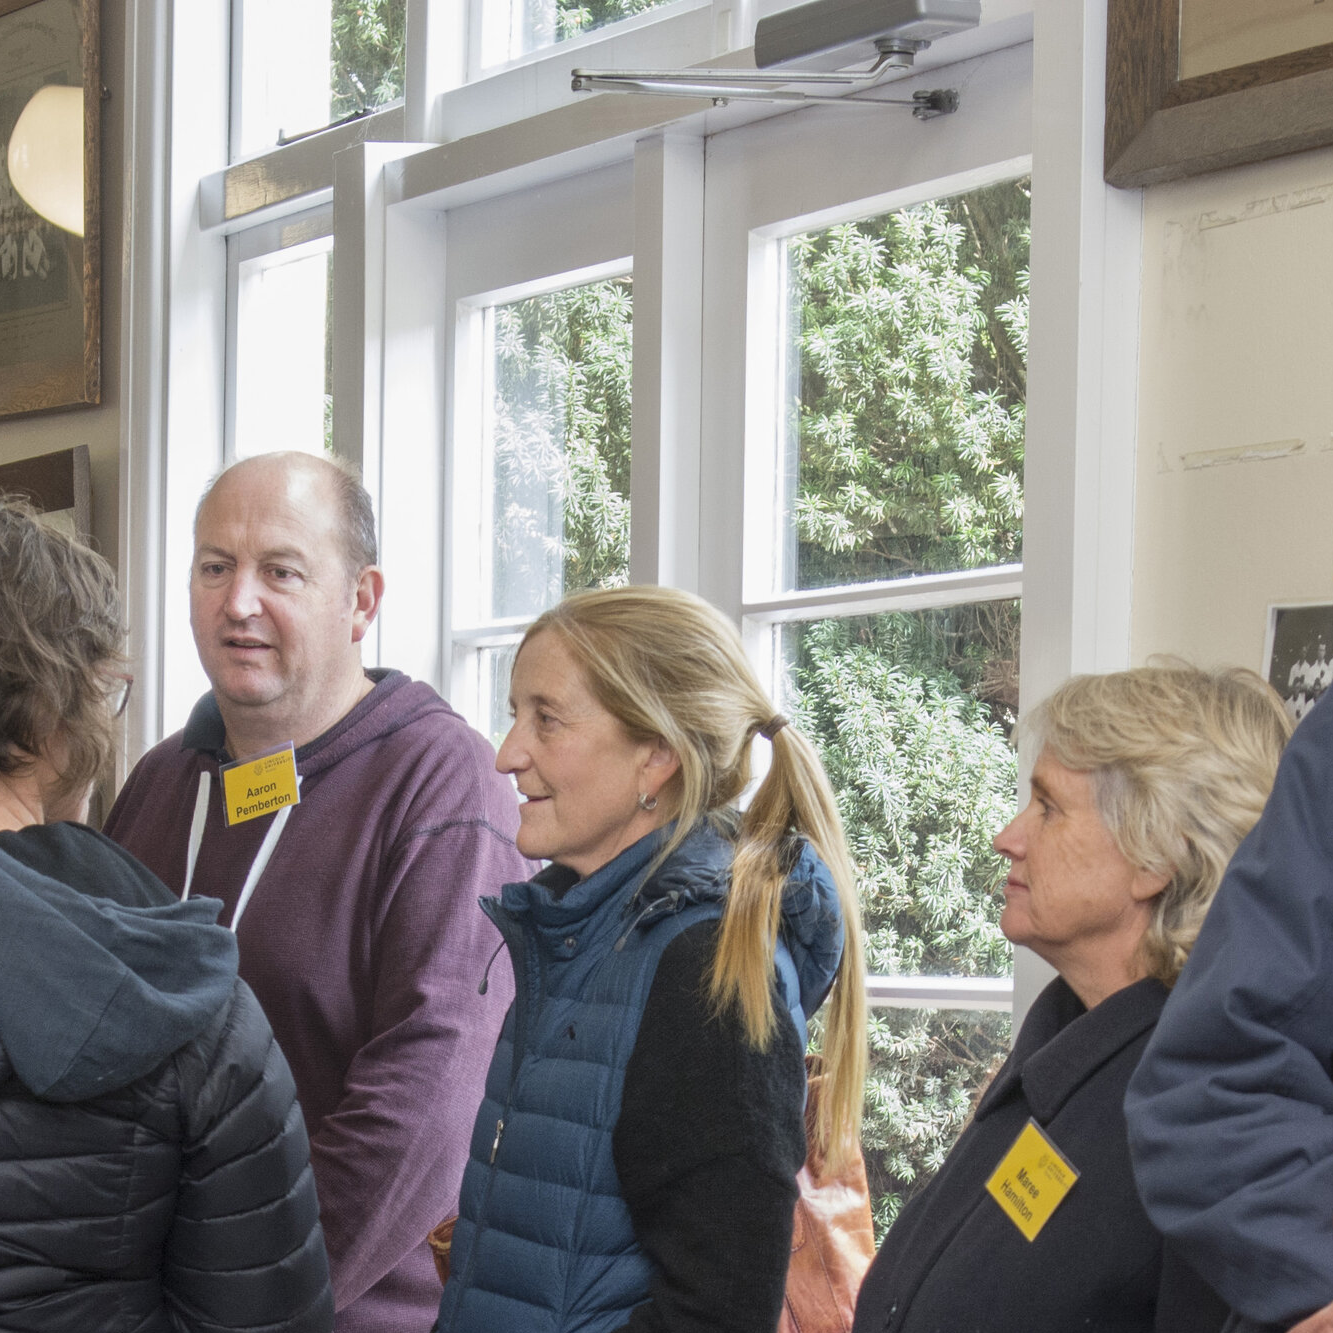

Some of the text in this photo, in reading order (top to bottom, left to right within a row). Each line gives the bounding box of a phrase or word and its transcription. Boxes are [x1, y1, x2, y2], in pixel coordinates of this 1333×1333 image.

[246, 782, 277, 799] Aaron
[236, 793, 292, 818] Pemberton
[1016, 1167, 1041, 1199] Maree
[1000, 1178, 1034, 1222] Hamilton
